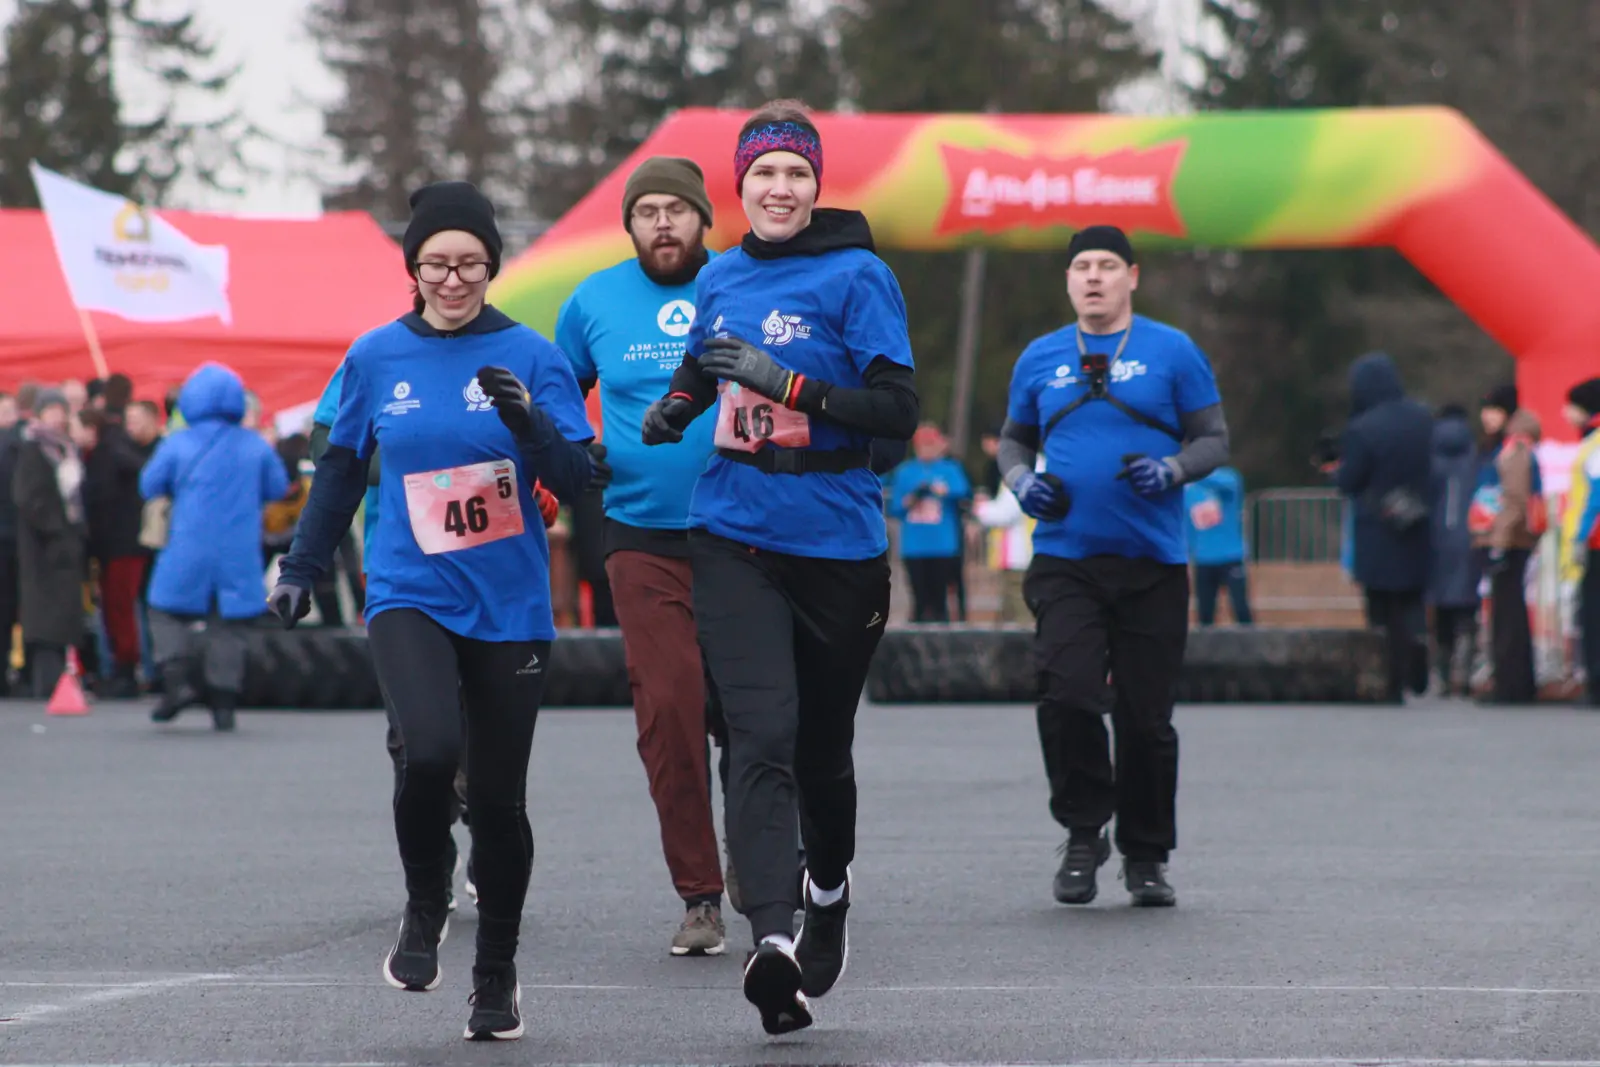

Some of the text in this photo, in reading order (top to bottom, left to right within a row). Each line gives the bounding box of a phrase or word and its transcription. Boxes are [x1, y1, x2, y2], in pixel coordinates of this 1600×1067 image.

[762, 310, 811, 346] 65 ЛЕТ
[734, 403, 774, 443] 46
[497, 476, 512, 499] 5
[444, 495, 489, 537] 46
